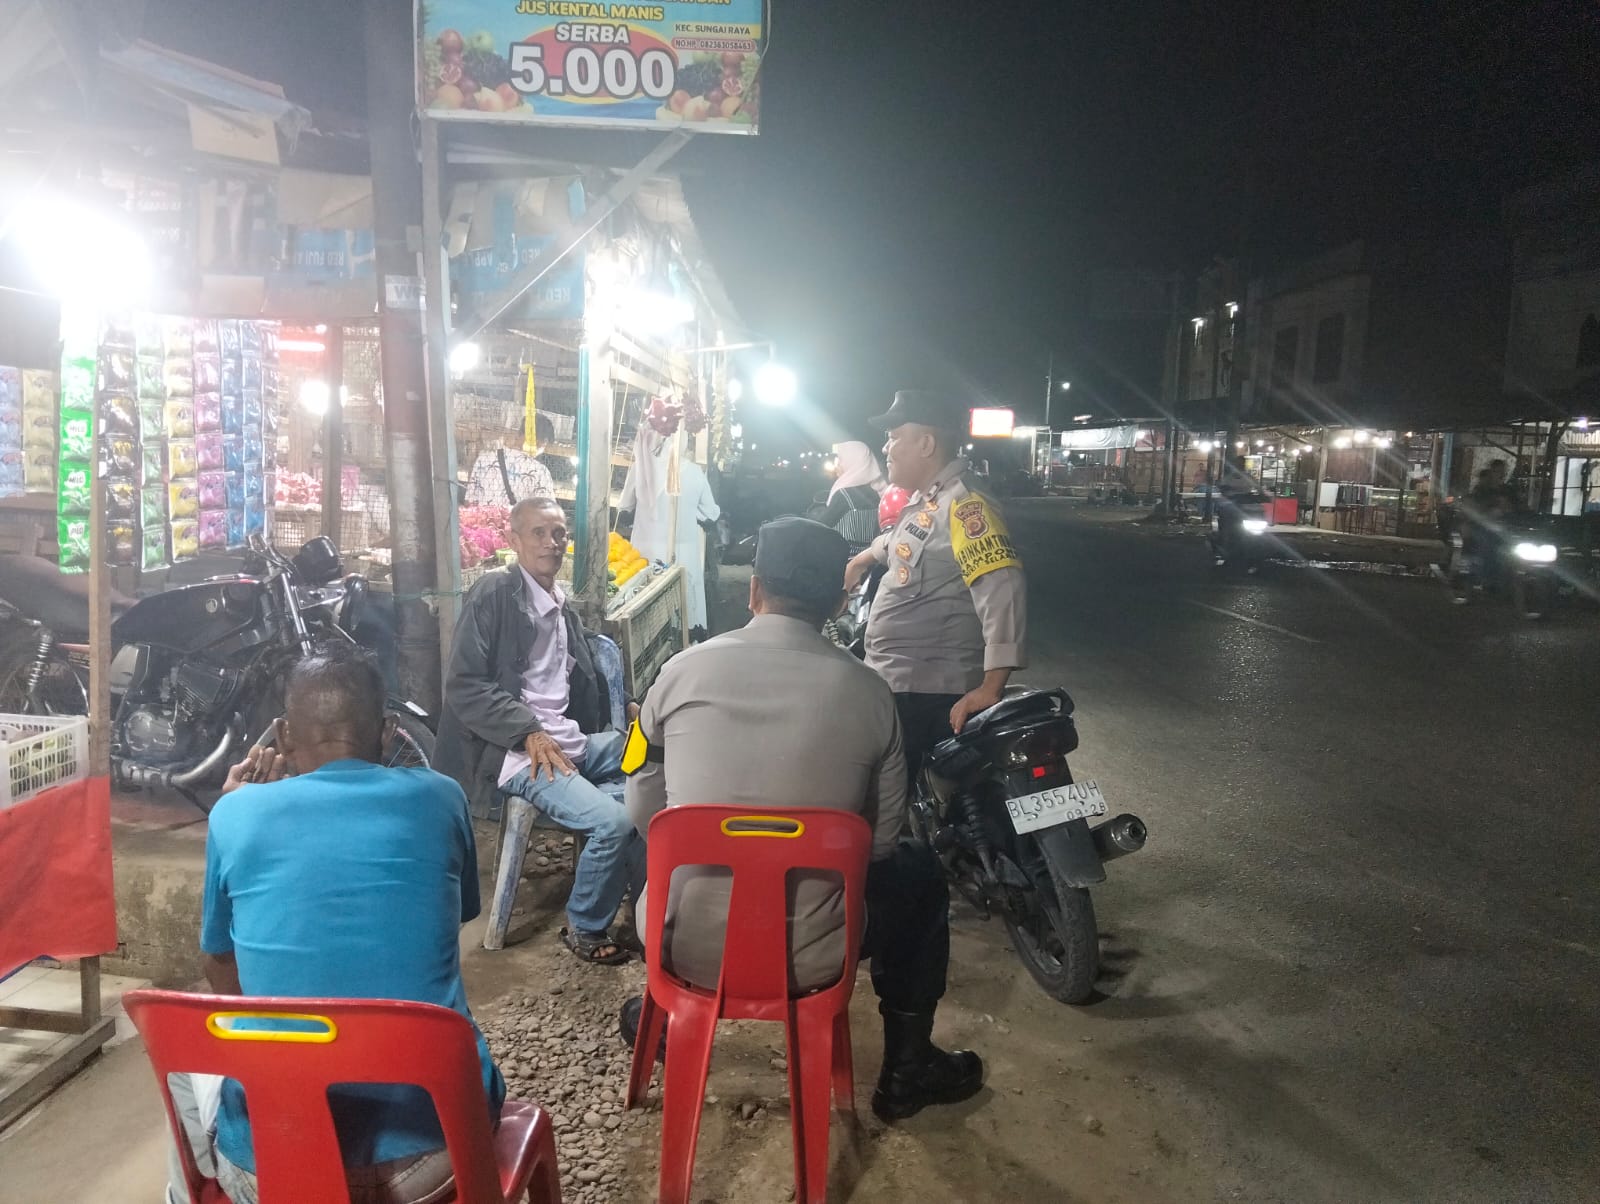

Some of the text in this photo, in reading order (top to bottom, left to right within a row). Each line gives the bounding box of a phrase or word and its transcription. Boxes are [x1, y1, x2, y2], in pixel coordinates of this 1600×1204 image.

[516, 0, 664, 21] JUS KENTAL MANIS
[556, 23, 630, 44] SERBA
[695, 25, 726, 33] SUNGAI
[728, 26, 750, 35] RAYA
[509, 41, 675, 98] 5.000
[1007, 799, 1032, 818] BL
[1075, 781, 1101, 800] UH
